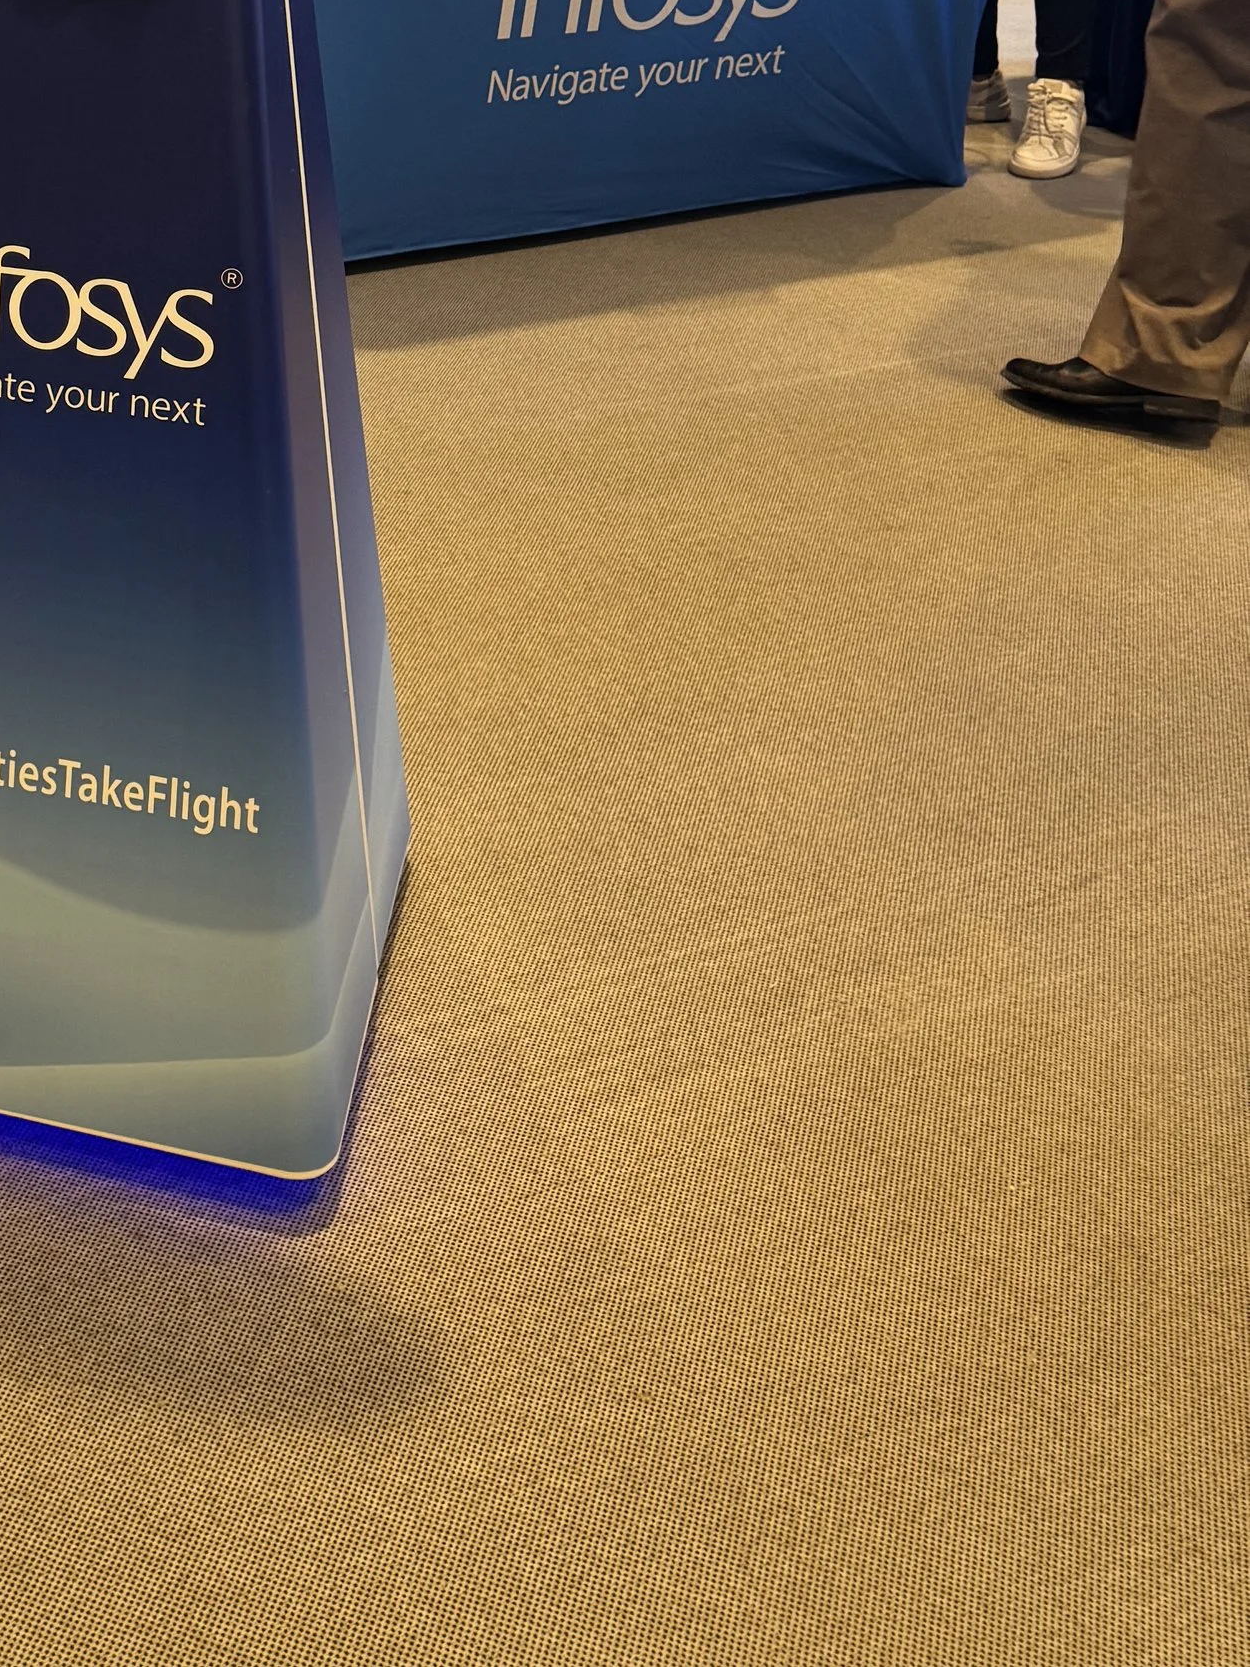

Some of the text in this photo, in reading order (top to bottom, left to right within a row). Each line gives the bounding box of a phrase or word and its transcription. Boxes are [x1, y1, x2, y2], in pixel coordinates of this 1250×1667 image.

[487, 45, 785, 106] Navigate your next
[45, 383, 120, 414] your
[131, 394, 207, 427] next
